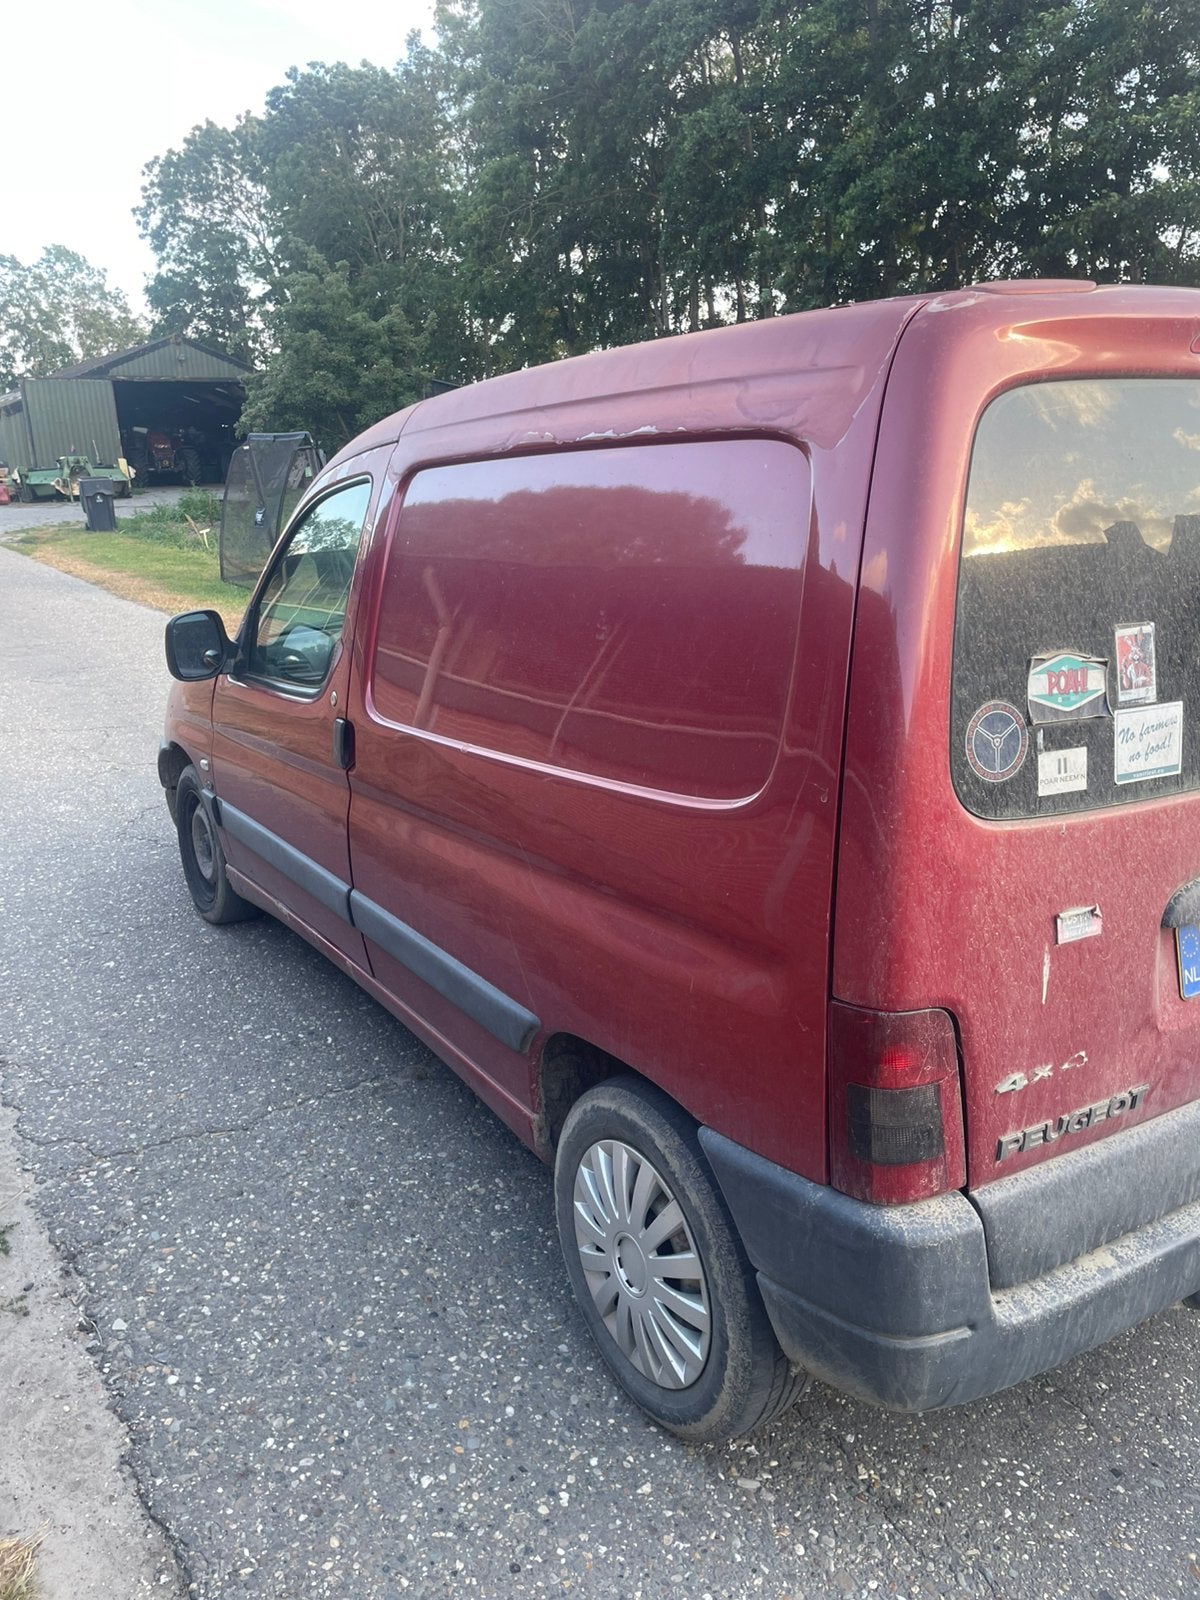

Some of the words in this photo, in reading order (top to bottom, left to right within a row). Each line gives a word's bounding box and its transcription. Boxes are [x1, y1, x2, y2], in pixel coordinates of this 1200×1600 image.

[1047, 667, 1088, 696] POAH!
[1118, 727, 1135, 744] No
[1139, 715, 1177, 742] farmers
[1129, 751, 1140, 762] no
[1144, 732, 1172, 761] food!
[1184, 966, 1200, 985] NL
[996, 1083, 1149, 1161] PEUGEOT
